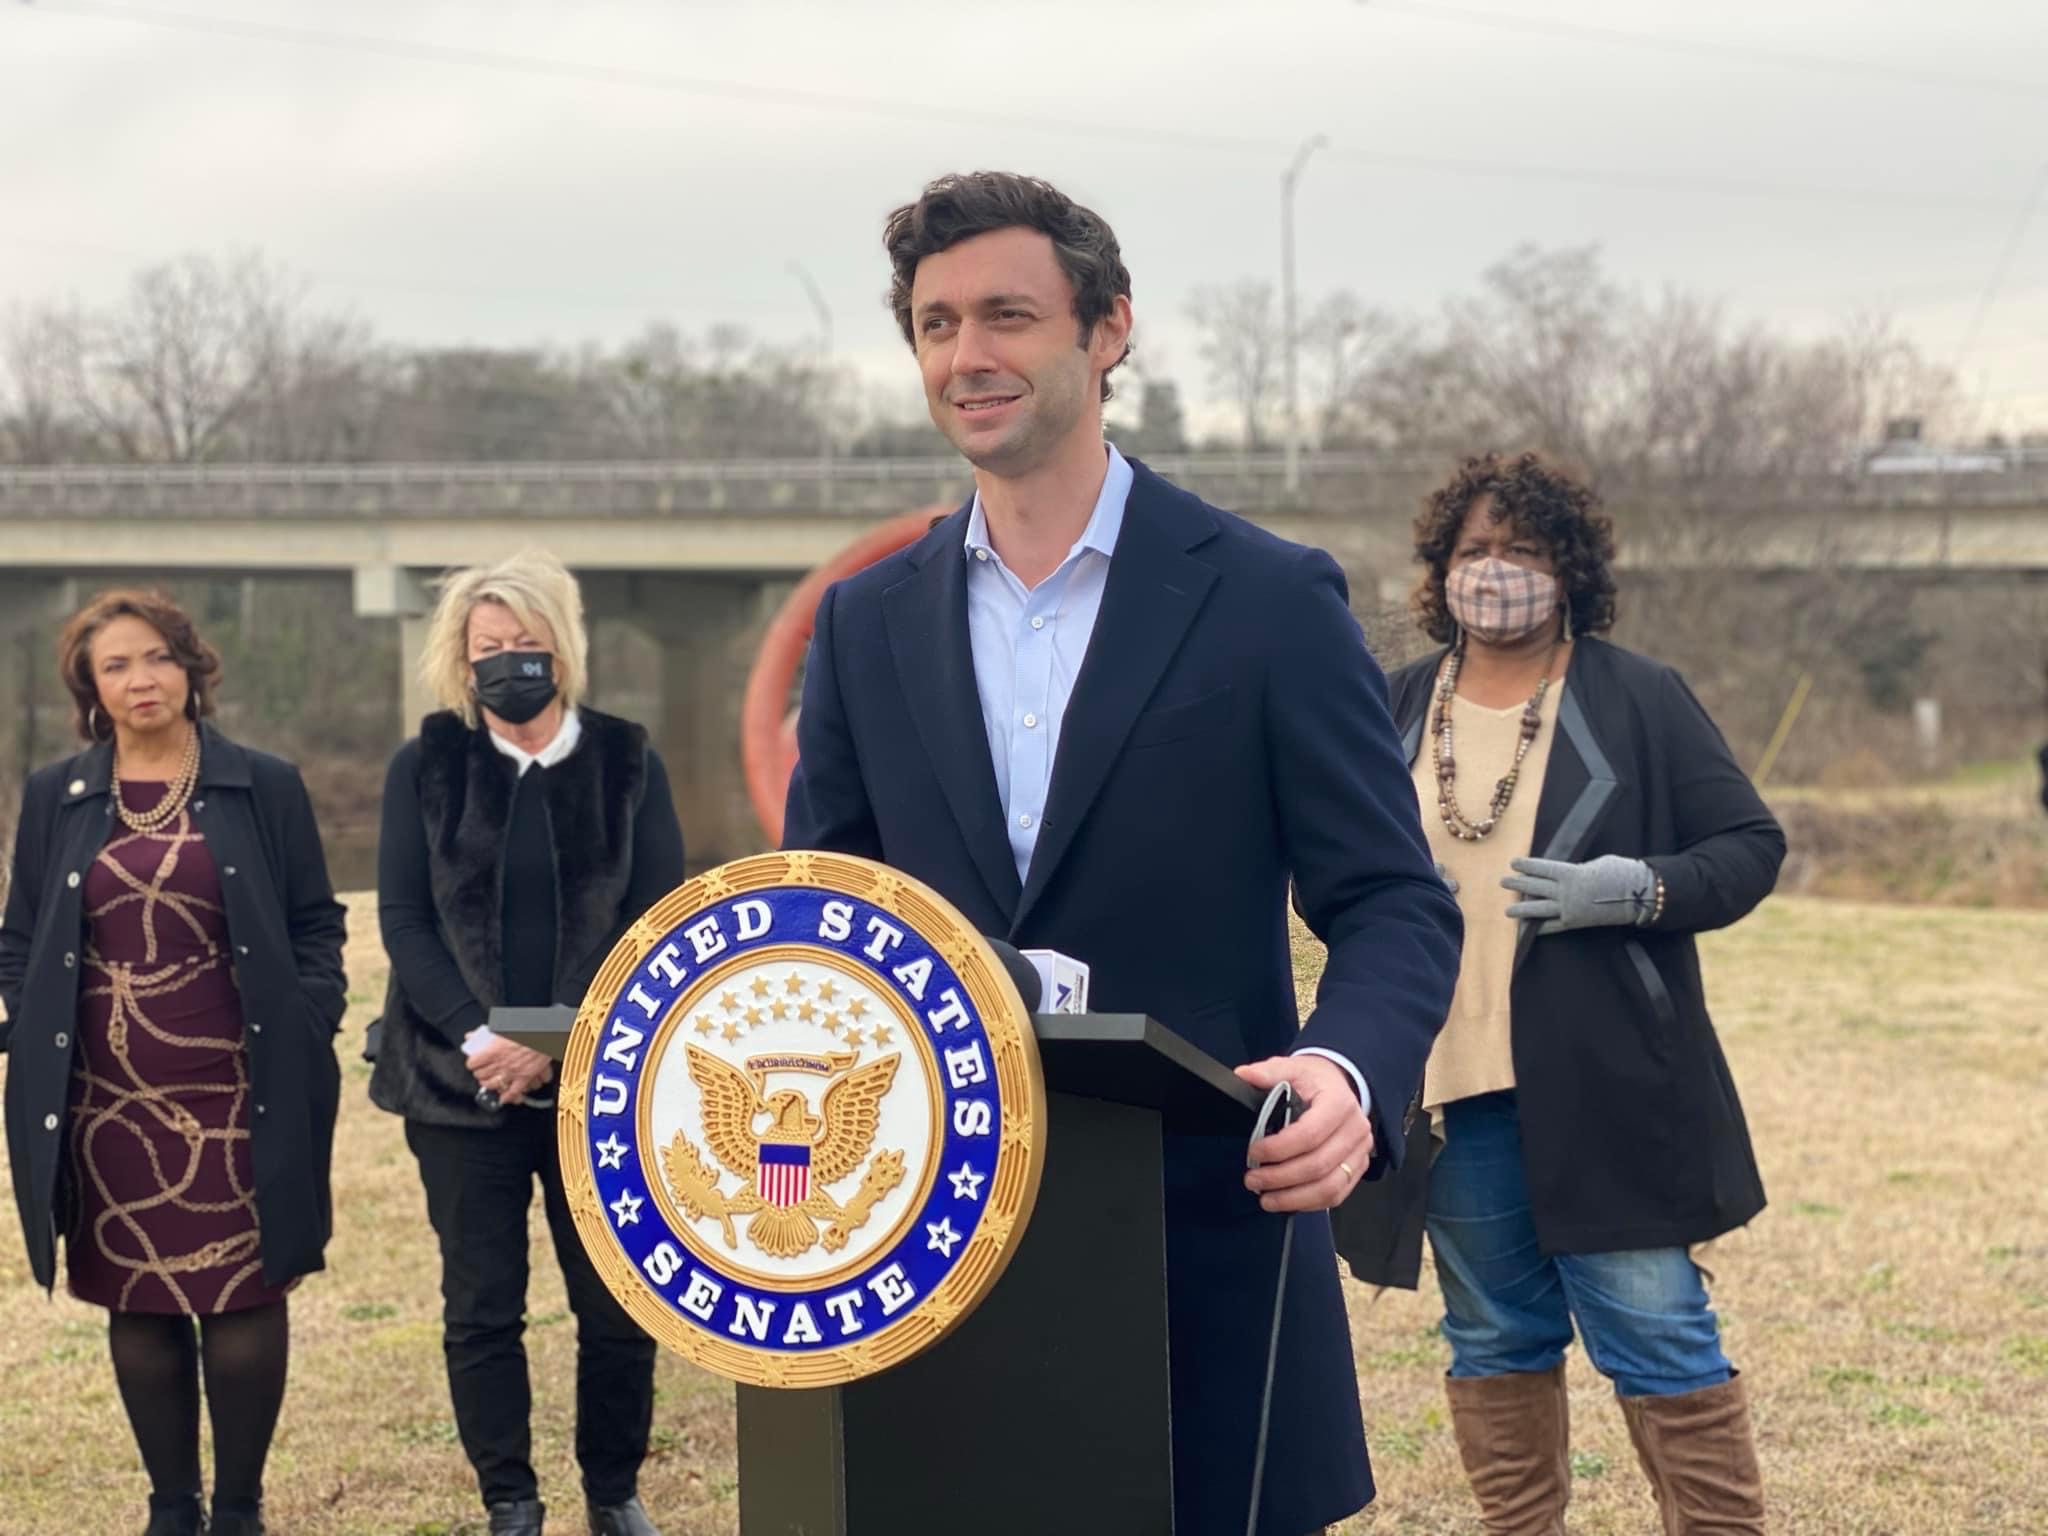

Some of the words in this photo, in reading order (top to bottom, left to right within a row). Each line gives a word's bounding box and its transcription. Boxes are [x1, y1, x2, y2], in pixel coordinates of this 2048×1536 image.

[593, 900, 772, 1117] UNITED
[818, 901, 991, 1138] STATES
[643, 1242, 915, 1344] SENATE
